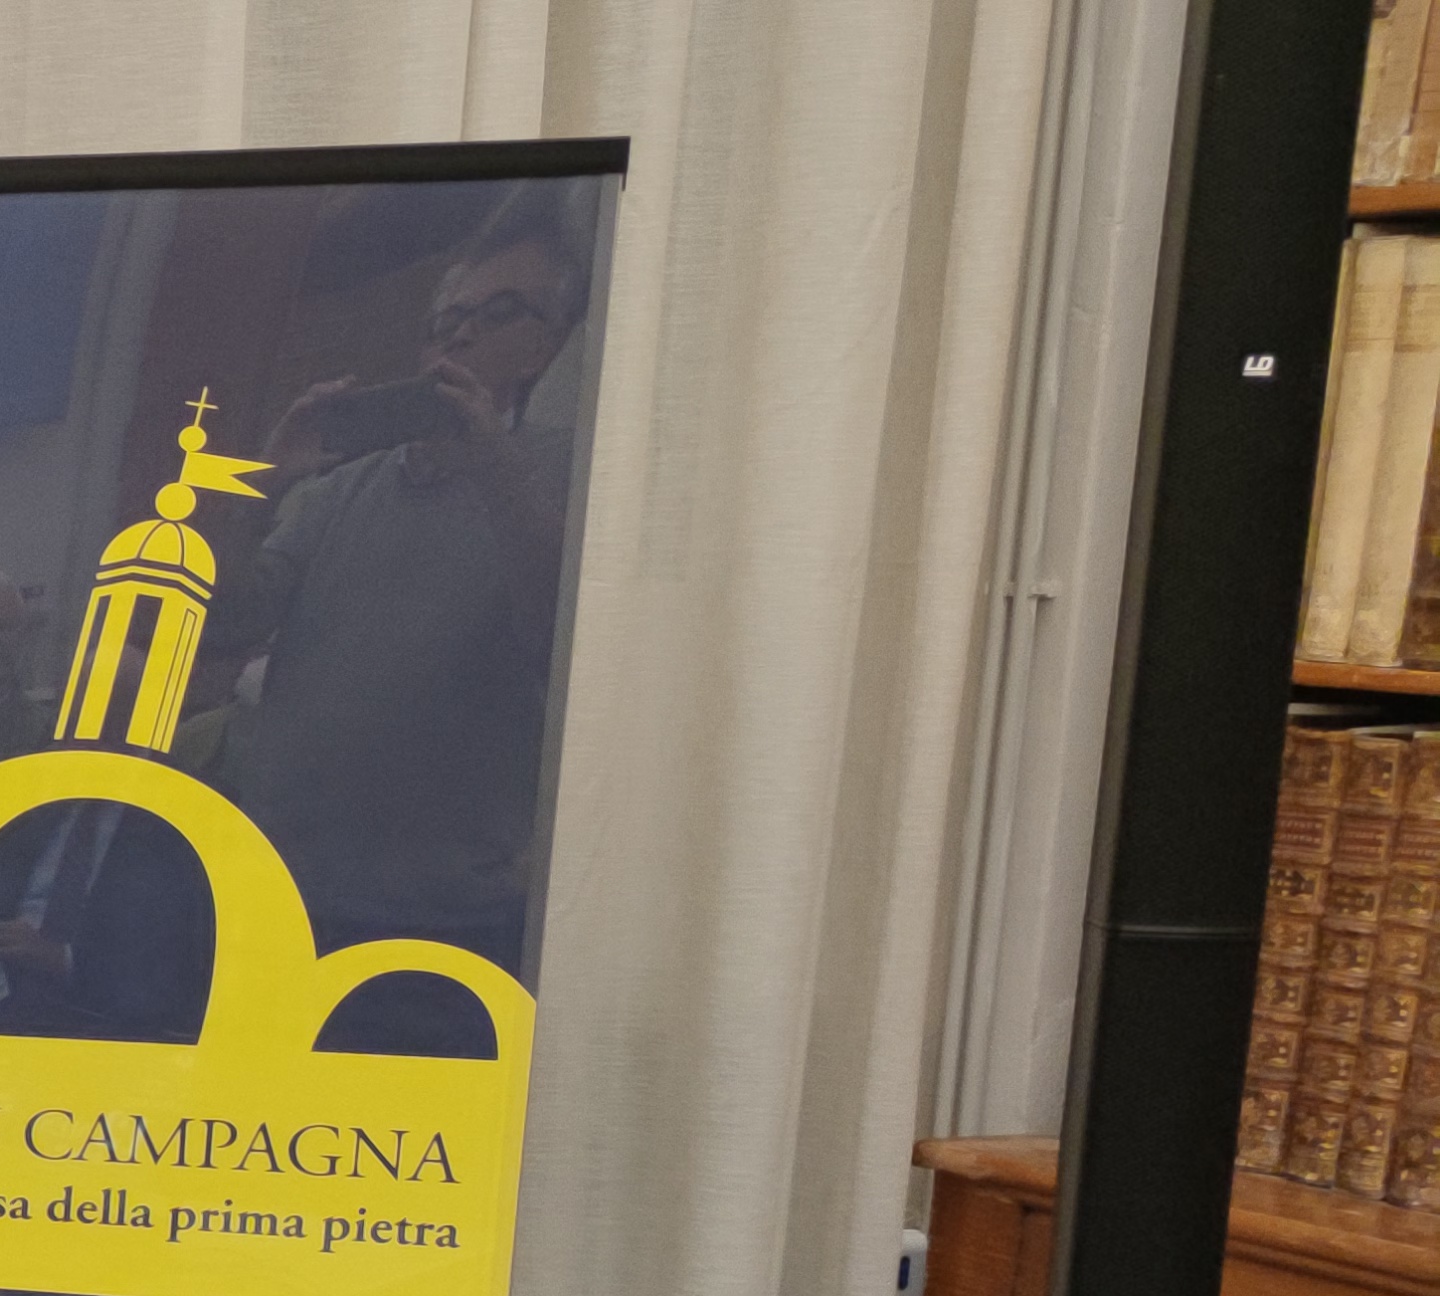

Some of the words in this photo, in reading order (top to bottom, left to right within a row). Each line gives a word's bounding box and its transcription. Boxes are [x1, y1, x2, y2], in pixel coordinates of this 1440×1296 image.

[23, 1108, 462, 1185] CAMPAGNA
[46, 1186, 155, 1229] della
[165, 1199, 308, 1244] prima
[319, 1207, 461, 1254] pietra
